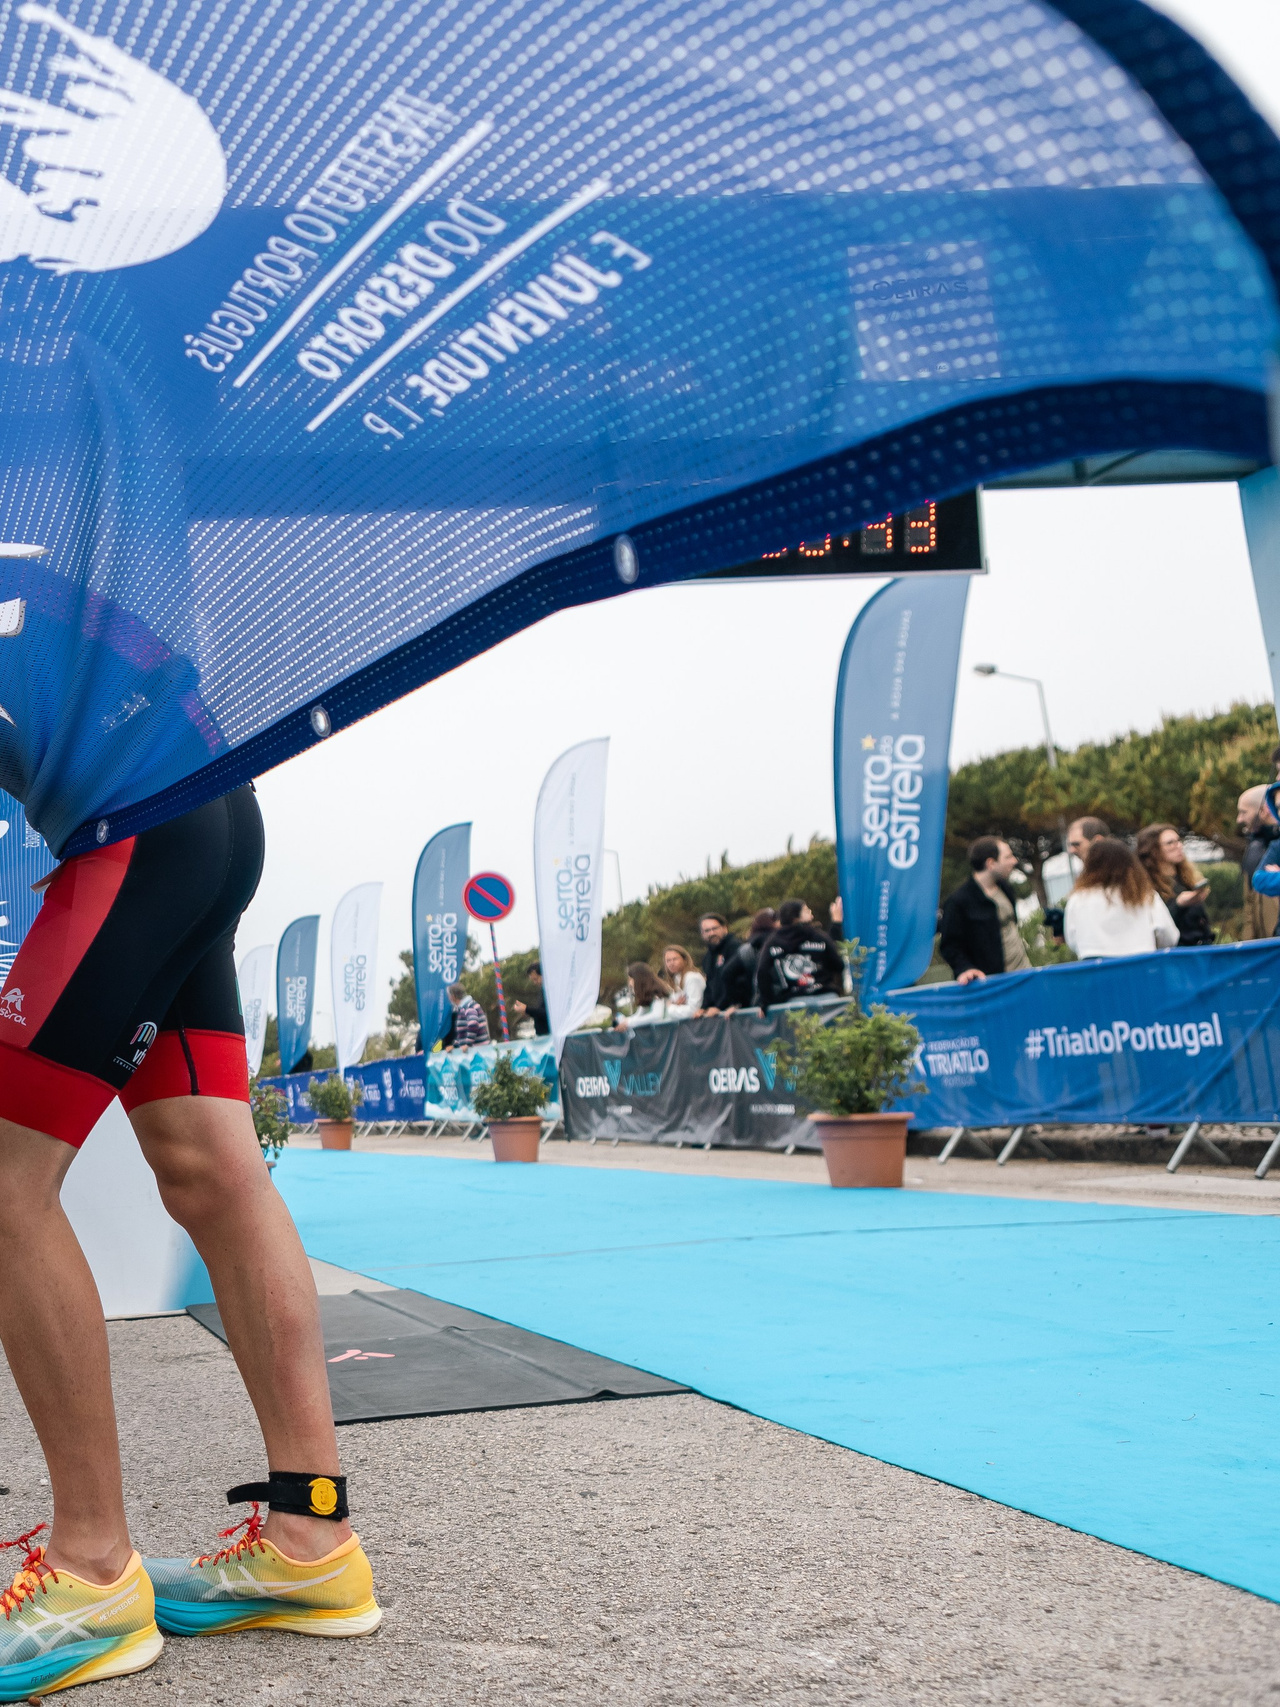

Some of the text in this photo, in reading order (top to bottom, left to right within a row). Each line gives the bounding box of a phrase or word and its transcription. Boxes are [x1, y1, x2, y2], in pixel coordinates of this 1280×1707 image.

[862, 755, 893, 849] serra
[888, 734, 925, 870] estrela
[555, 869, 574, 930] serra
[575, 854, 591, 942] estrela
[428, 924, 442, 973] serra
[442, 913, 457, 983] estrela
[296, 976, 307, 1026] estrela
[355, 955, 366, 1011] estrela
[1025, 1012, 1223, 1060] #TriatloPortugal
[576, 1075, 610, 1098] OEIRAS
[708, 1067, 760, 1095] OEIRAS
[925, 1048, 990, 1078] TRIATLO
